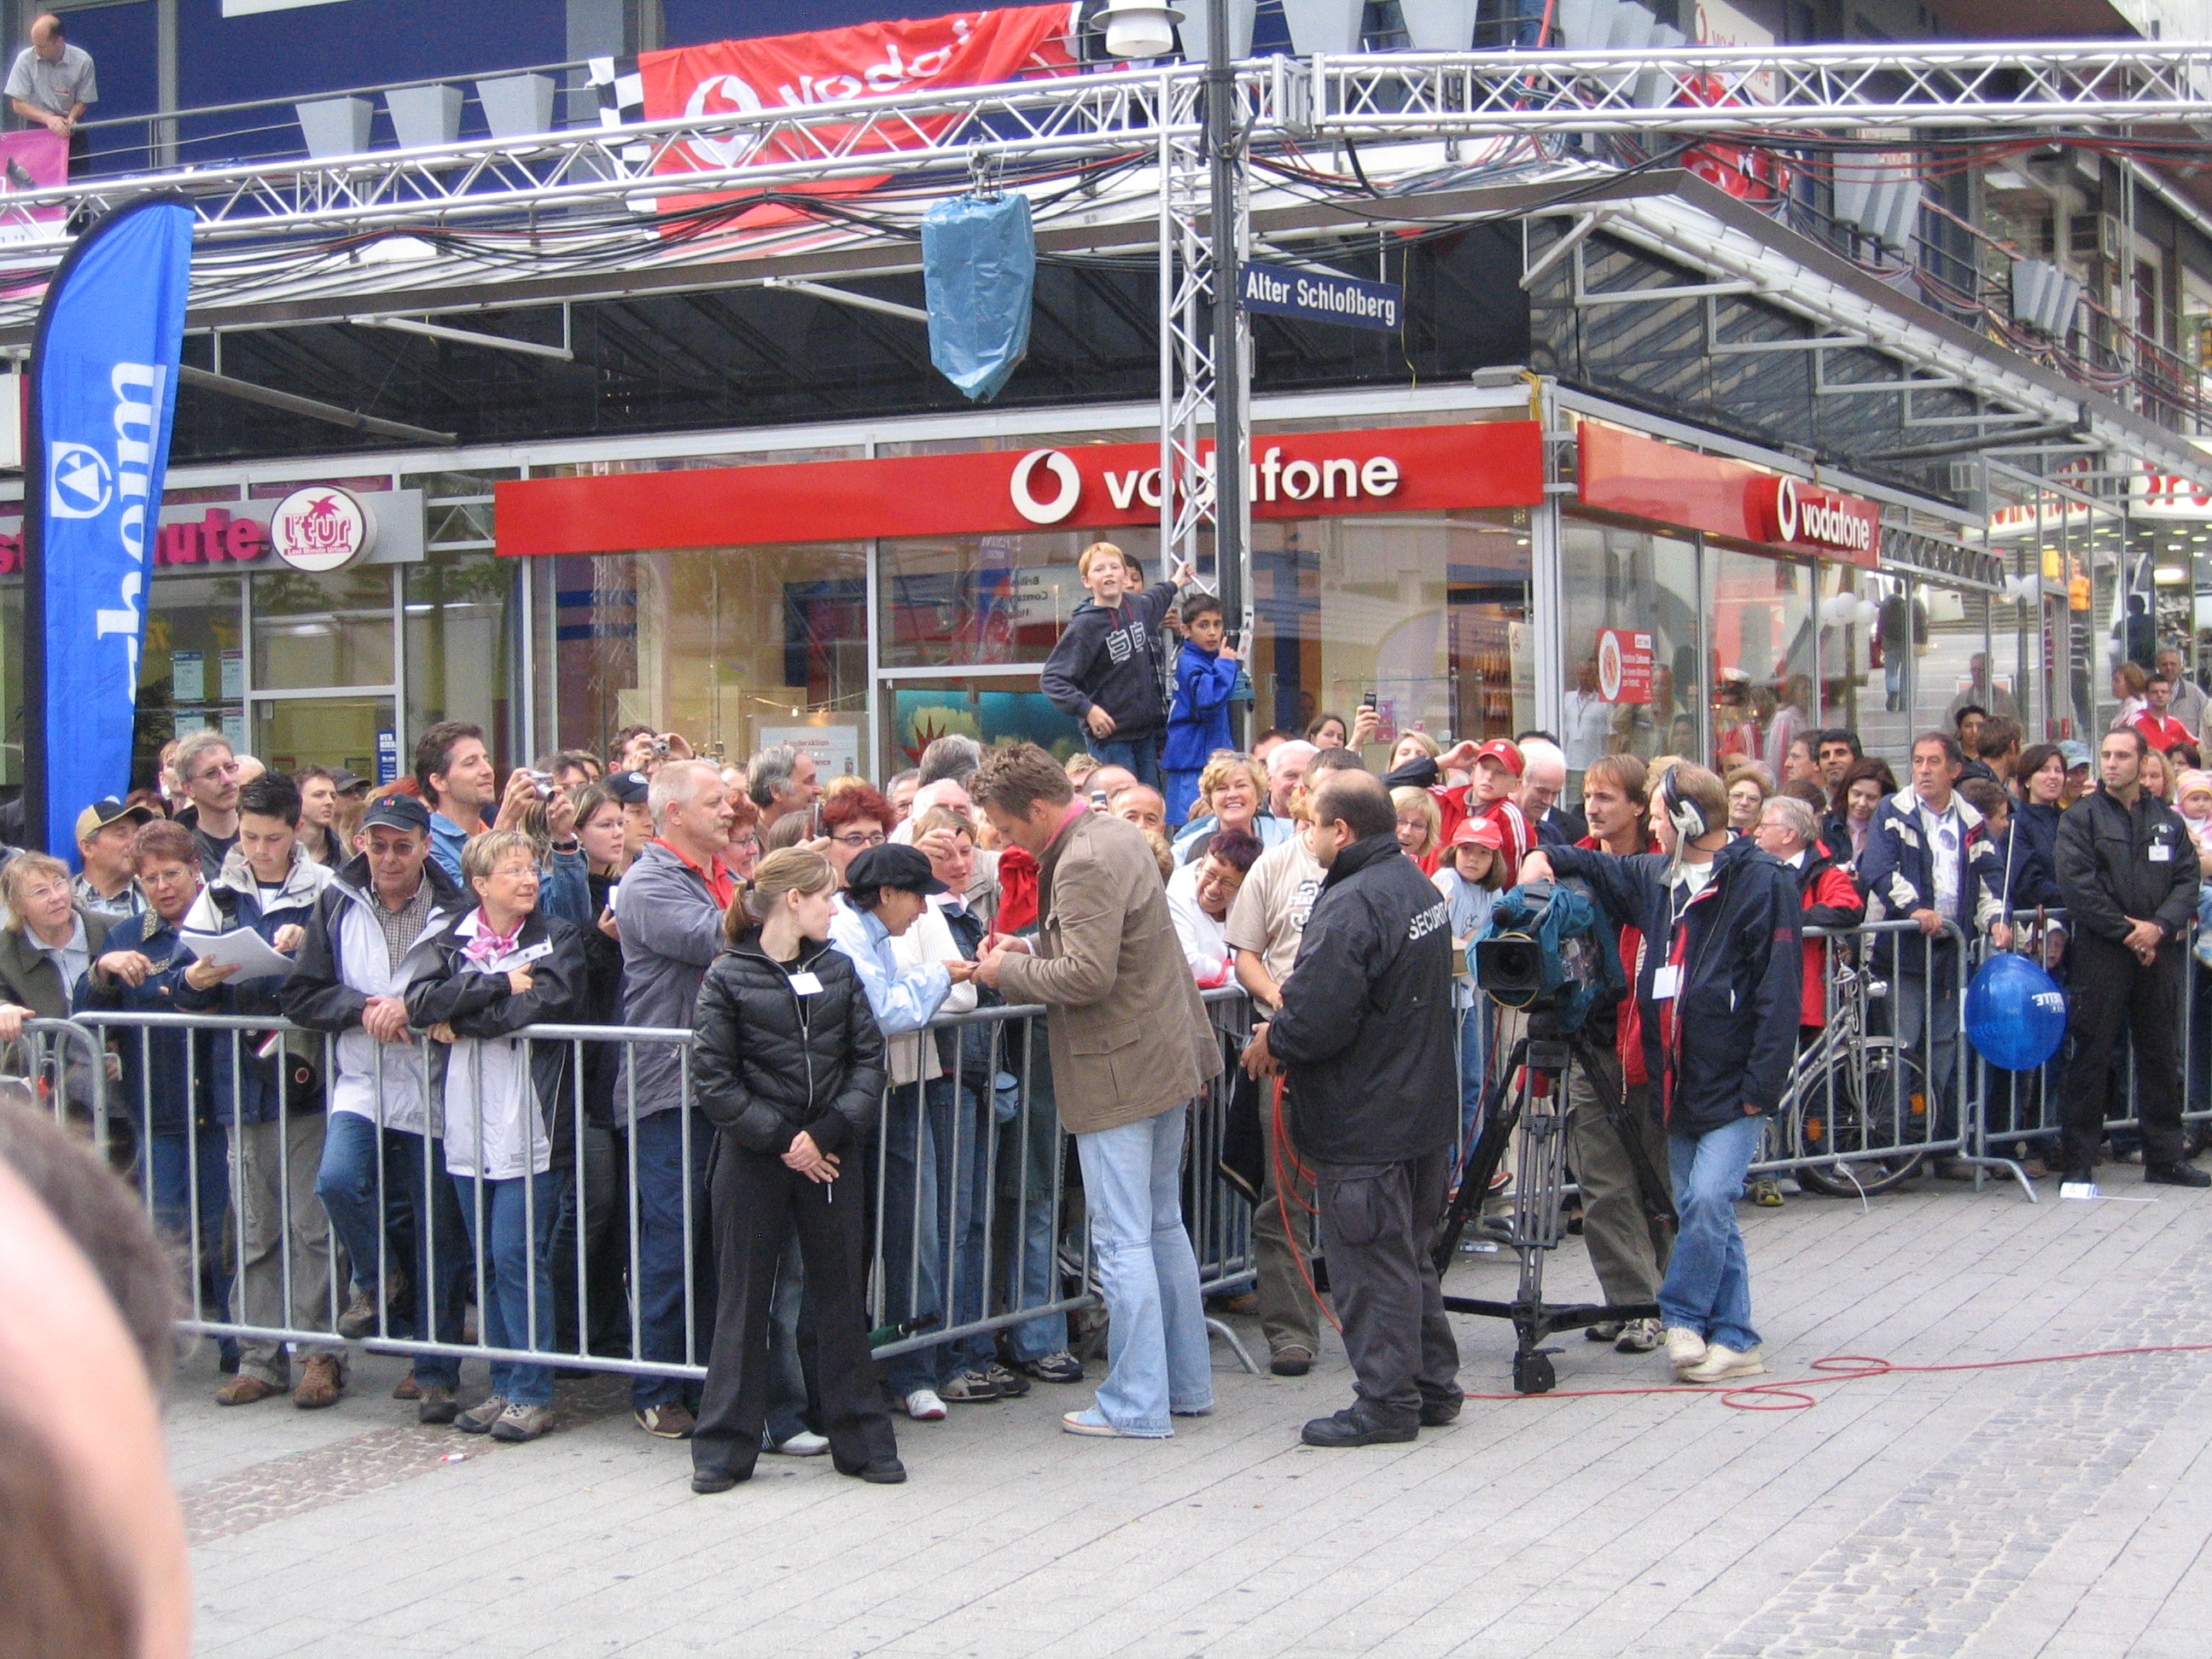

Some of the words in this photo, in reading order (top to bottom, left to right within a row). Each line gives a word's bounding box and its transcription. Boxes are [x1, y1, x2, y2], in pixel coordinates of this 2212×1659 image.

[1246, 271, 1290, 304] Alter
[1297, 278, 1395, 327] Schloßberg
[1103, 446, 1400, 509] vodfone
[1802, 496, 1869, 550] vodafone
[1409, 901, 1449, 940] SECURIT
